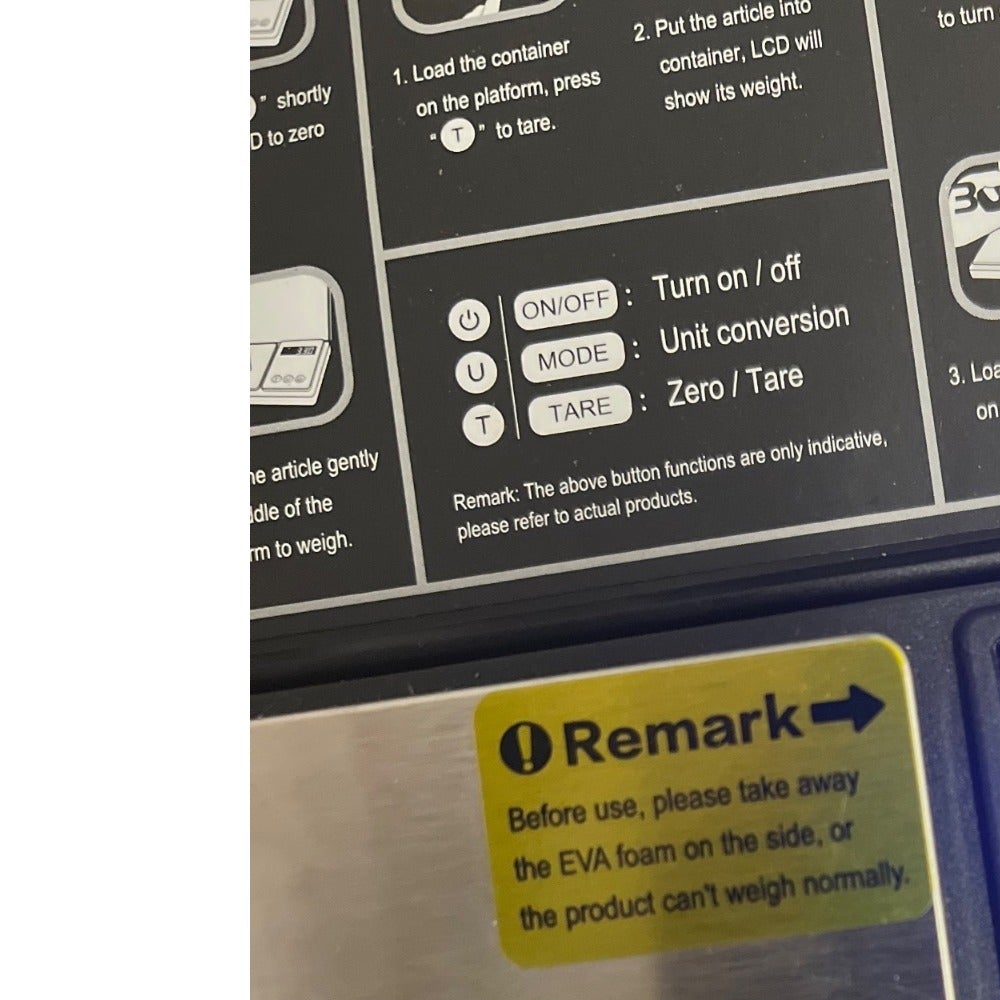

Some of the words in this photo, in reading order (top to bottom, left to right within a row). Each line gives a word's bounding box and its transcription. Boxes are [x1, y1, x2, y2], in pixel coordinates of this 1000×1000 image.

[633, 23, 651, 42] 2.
[655, 16, 686, 38] Put
[689, 12, 717, 32] the
[723, 2, 774, 27] article
[779, 0, 811, 17] into
[937, 10, 955, 28] to
[960, 5, 994, 25] turn
[393, 69, 408, 85] 1.
[412, 57, 455, 83] Load
[459, 53, 487, 78] the
[491, 38, 570, 68] container
[660, 45, 746, 76] container,
[750, 35, 790, 60] LCD
[794, 28, 823, 51] will
[277, 84, 331, 109] shortly
[416, 99, 438, 117] on
[442, 91, 470, 112] the
[473, 81, 549, 111] platform,
[553, 69, 601, 97] press
[664, 86, 710, 110] show
[715, 80, 736, 103] its
[740, 71, 803, 99] weight.
[267, 130, 284, 146] to
[287, 123, 325, 142] zero
[496, 121, 513, 140] to
[517, 116, 556, 134] tare.
[522, 289, 611, 320] ON/OFF
[652, 273, 710, 302] Turn
[717, 266, 751, 293] on
[755, 258, 763, 286] /
[770, 253, 801, 283] off
[467, 361, 485, 382] U
[537, 343, 609, 371] MODE
[659, 323, 711, 354] Unit
[716, 303, 850, 347] conversion
[475, 415, 491, 435] T
[548, 396, 612, 424] TARE
[667, 379, 724, 408] Zero
[731, 370, 740, 398] /
[744, 364, 804, 394] Tare
[948, 366, 966, 387] 3.
[975, 402, 999, 421] on
[271, 457, 323, 483] article
[327, 448, 379, 478] gently
[453, 485, 520, 511] Remark:
[524, 480, 555, 501] The
[559, 472, 607, 496] above
[611, 464, 661, 487] button
[665, 451, 736, 480] functions
[740, 448, 766, 466] are
[770, 441, 803, 465] only
[807, 430, 888, 457] indicative,
[284, 497, 302, 518] of
[305, 495, 333, 515] the
[457, 519, 510, 543] please
[513, 510, 550, 532] refer
[554, 508, 570, 525] to
[574, 498, 621, 522] actual
[625, 489, 698, 518] products.
[275, 540, 292, 558] to
[296, 529, 353, 555] weigh.
[563, 692, 804, 767] Remark
[508, 803, 586, 833] Before
[594, 796, 645, 822] use,
[653, 786, 731, 818] please
[739, 775, 790, 805] take
[797, 768, 860, 798] away
[514, 854, 551, 882] the
[559, 846, 611, 877] EVA
[616, 841, 676, 870] foam
[684, 838, 714, 860] on
[721, 827, 759, 856] the
[766, 822, 824, 850] side,
[829, 820, 853, 842] or
[520, 903, 557, 931] the
[565, 891, 655, 930] product
[662, 882, 719, 915] can't
[726, 873, 796, 907] weigh
[803, 861, 910, 894] normally.
